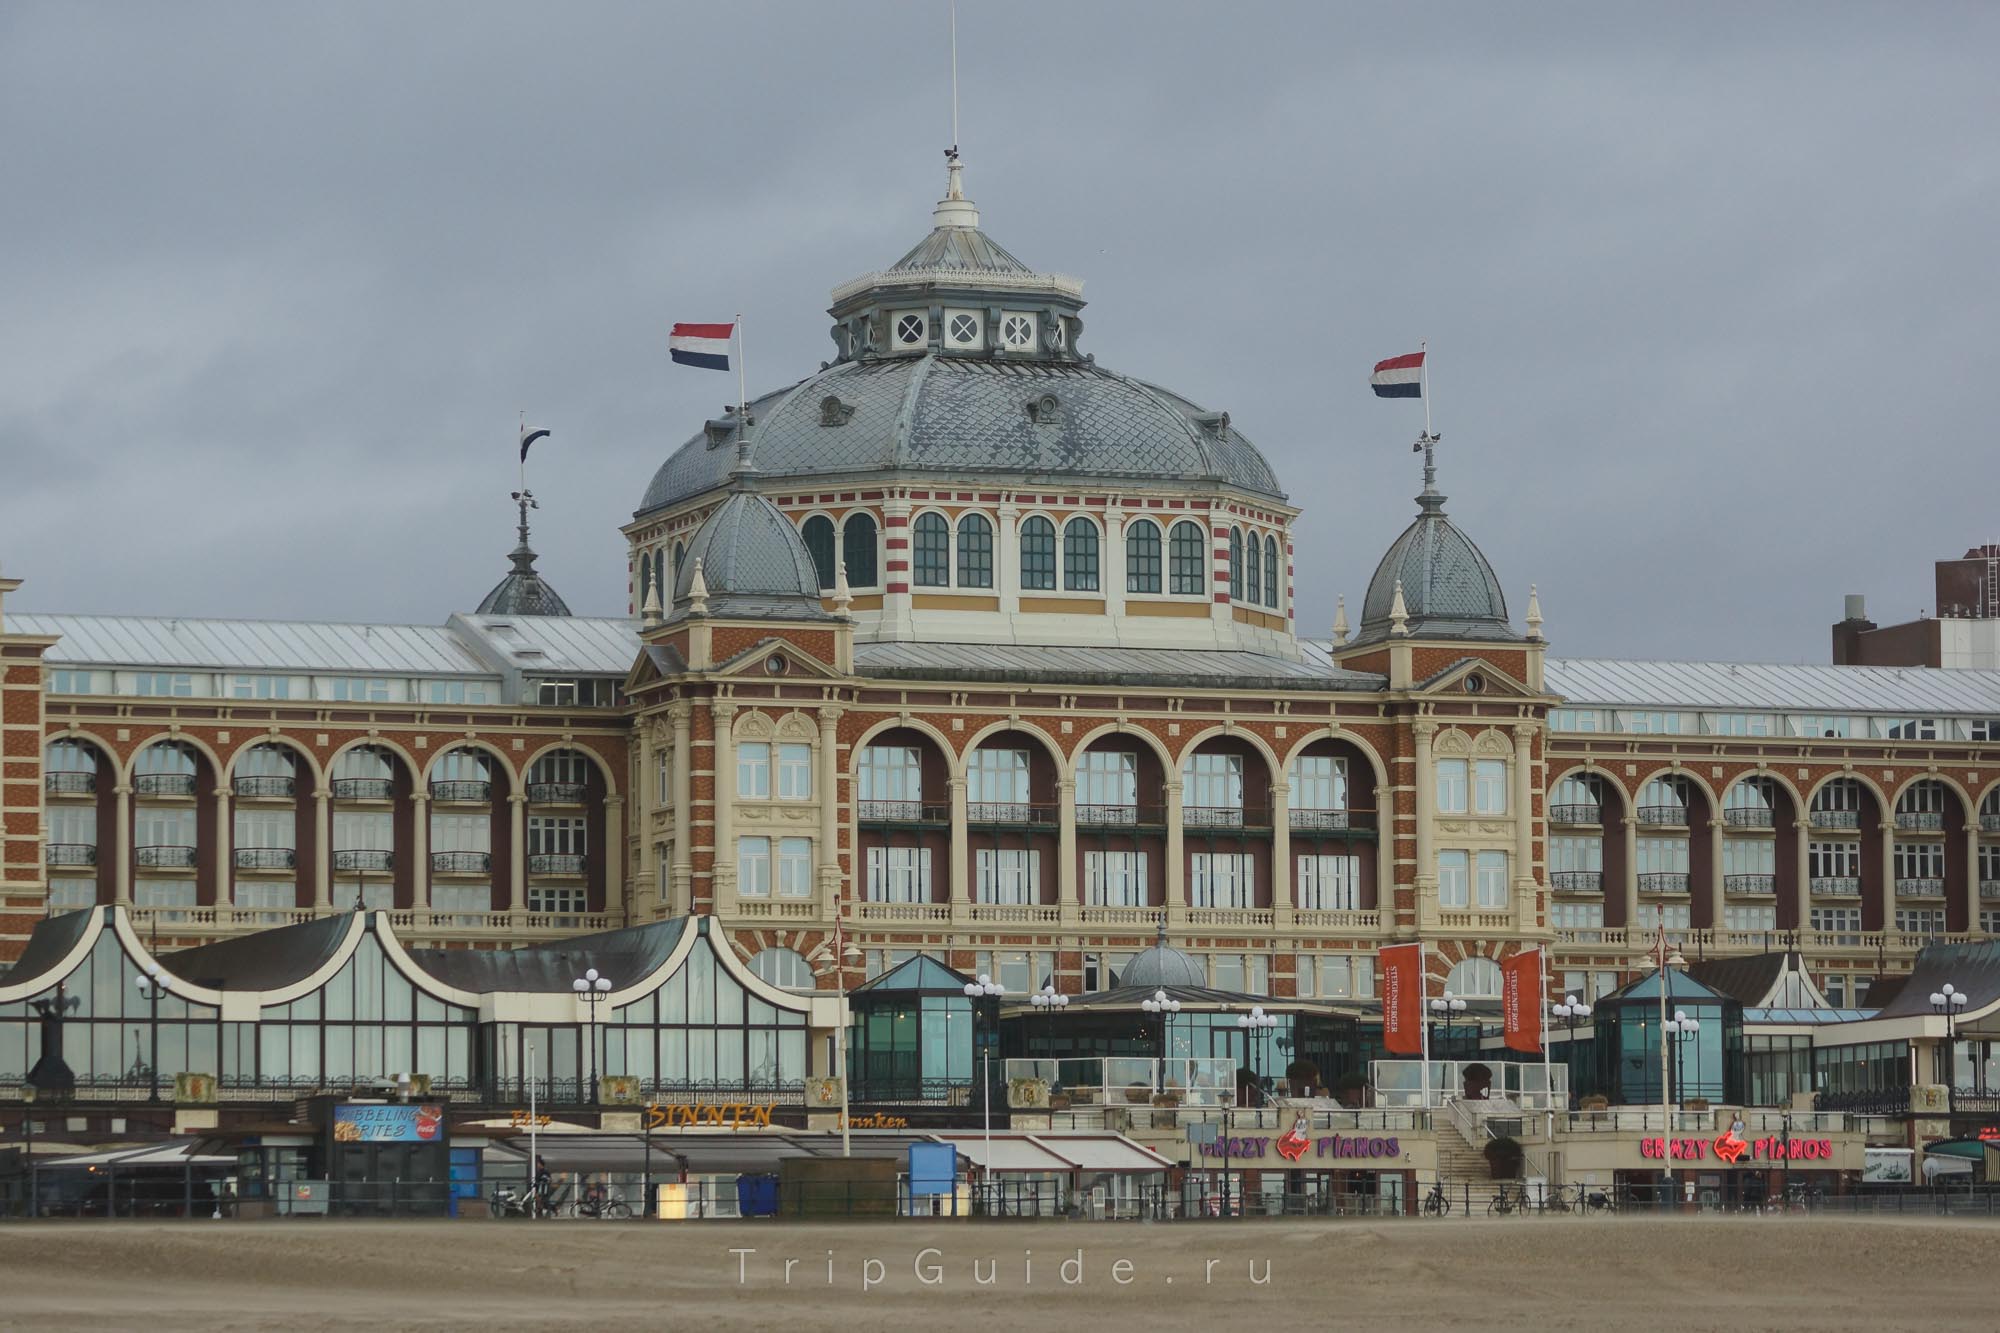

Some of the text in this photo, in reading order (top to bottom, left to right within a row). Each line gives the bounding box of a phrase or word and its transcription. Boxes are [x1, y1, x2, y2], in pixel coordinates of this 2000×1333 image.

[1390, 966, 1398, 1032] STEIGENBERGER
[1511, 969, 1519, 1032] STEIGENBERGER
[338, 1109, 416, 1122] BBELING
[648, 1101, 777, 1129] BINNEN
[1317, 1134, 1400, 1158] PIANOS
[1641, 1137, 1709, 1160] CRAZY
